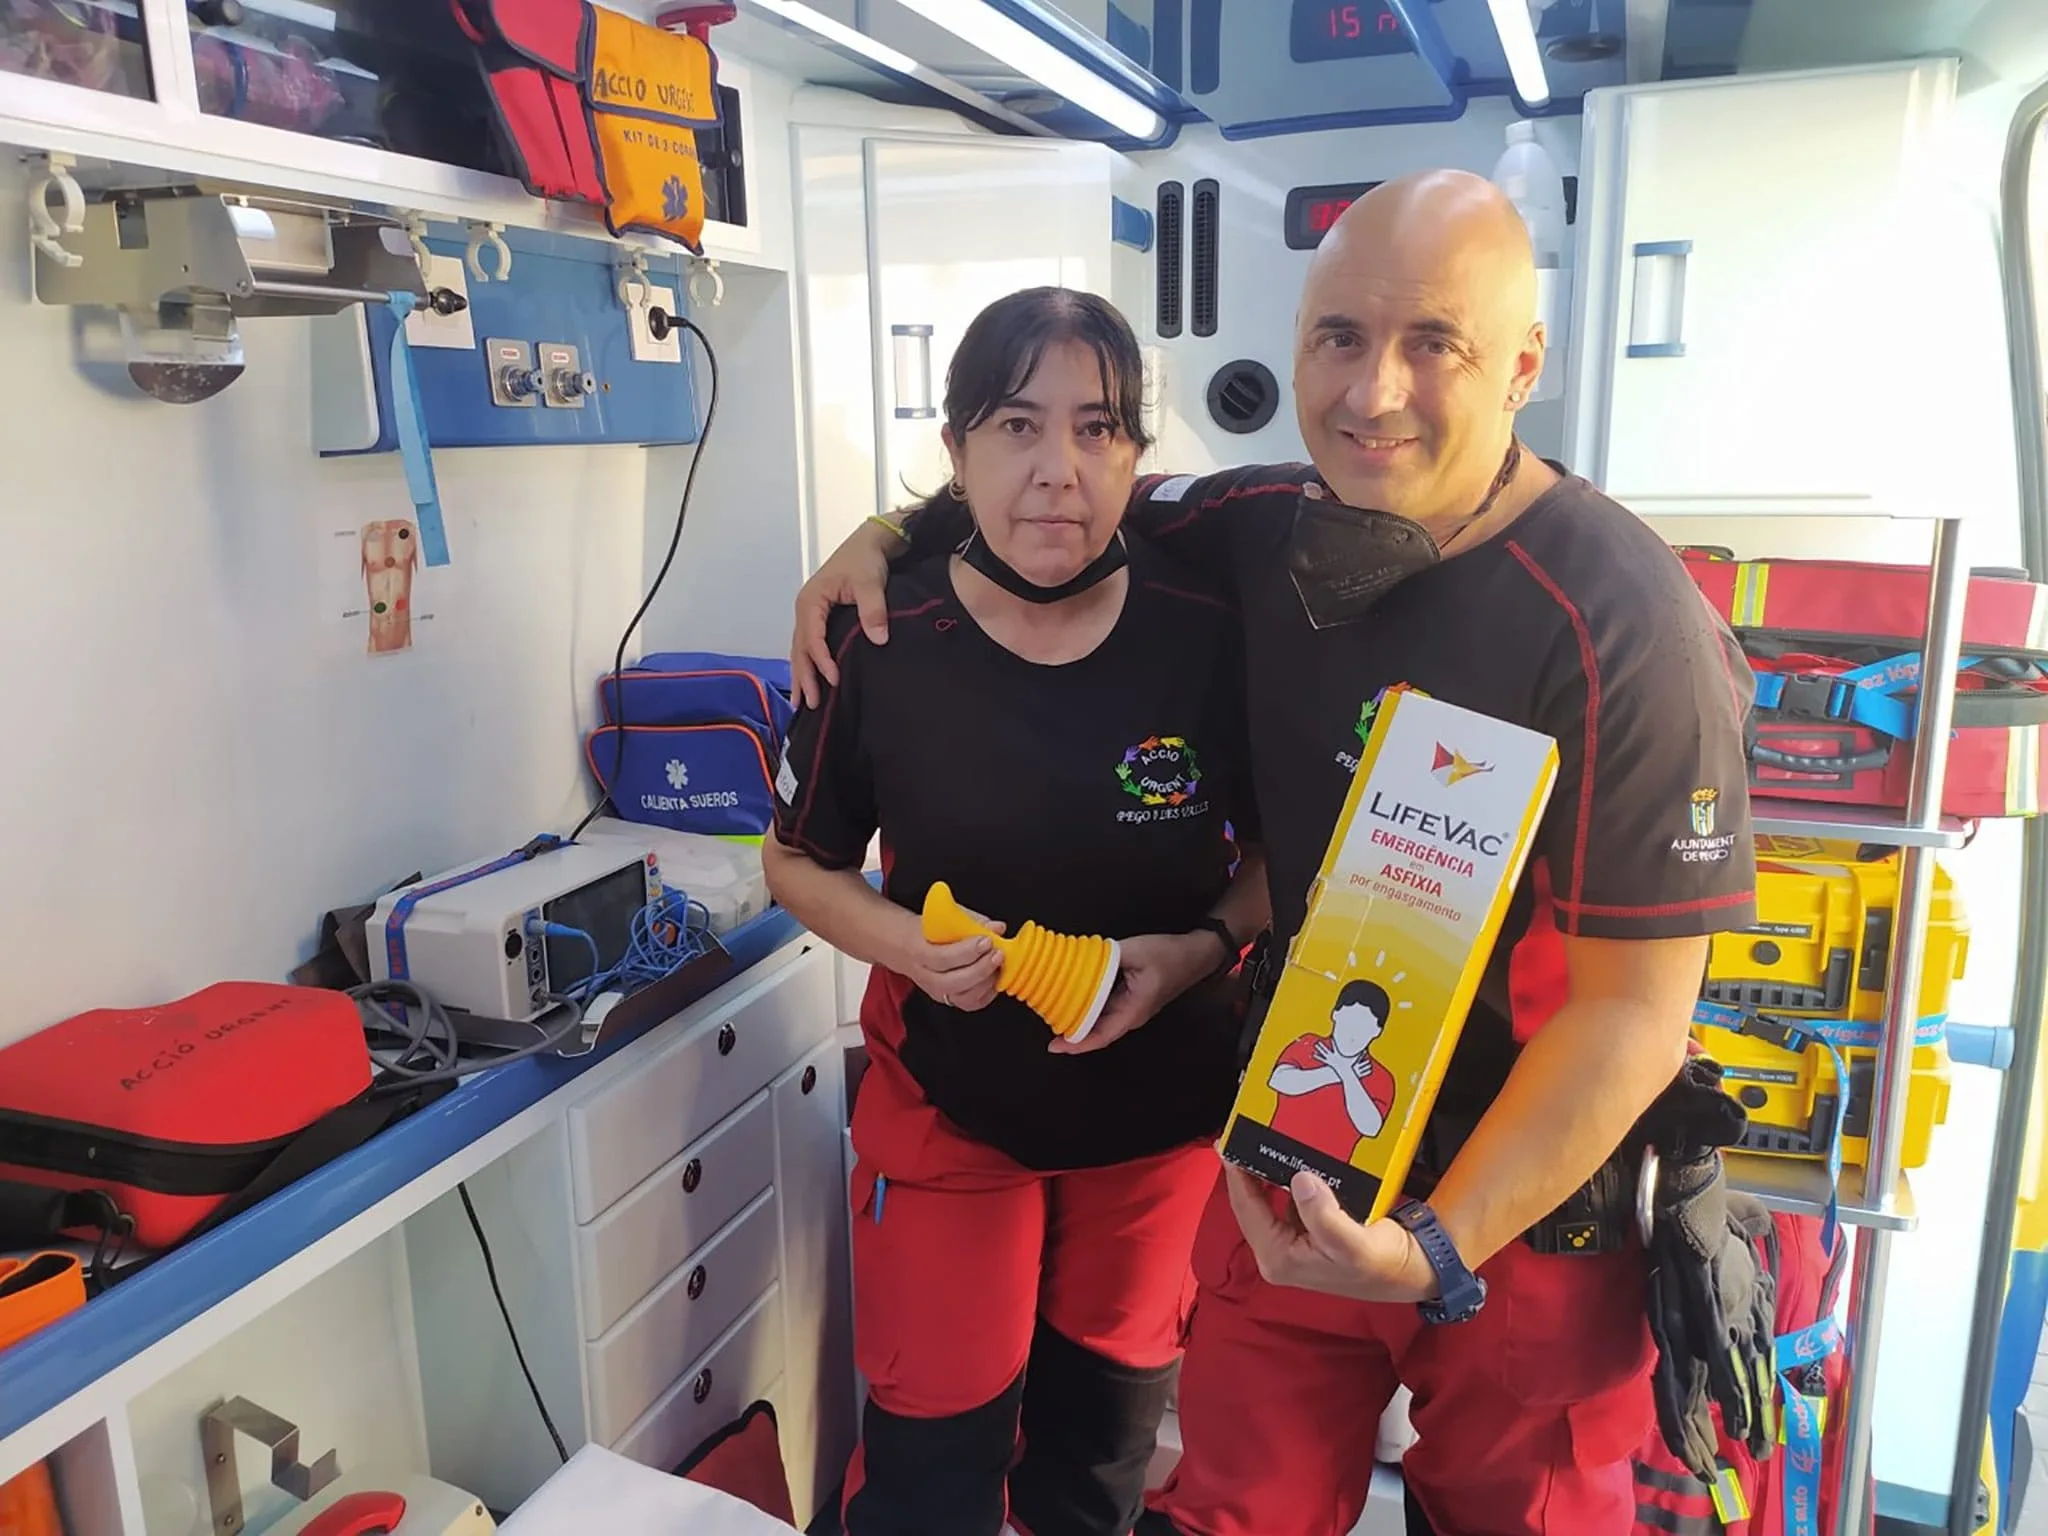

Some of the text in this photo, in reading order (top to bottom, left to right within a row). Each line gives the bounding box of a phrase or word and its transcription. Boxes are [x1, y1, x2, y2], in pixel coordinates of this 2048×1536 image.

[1335, 751, 1359, 773] PEG
[640, 791, 739, 810] CALIENTA SUEROS
[1380, 863, 1444, 898] ASFIXIA
[1349, 873, 1463, 923] por engasgamento
